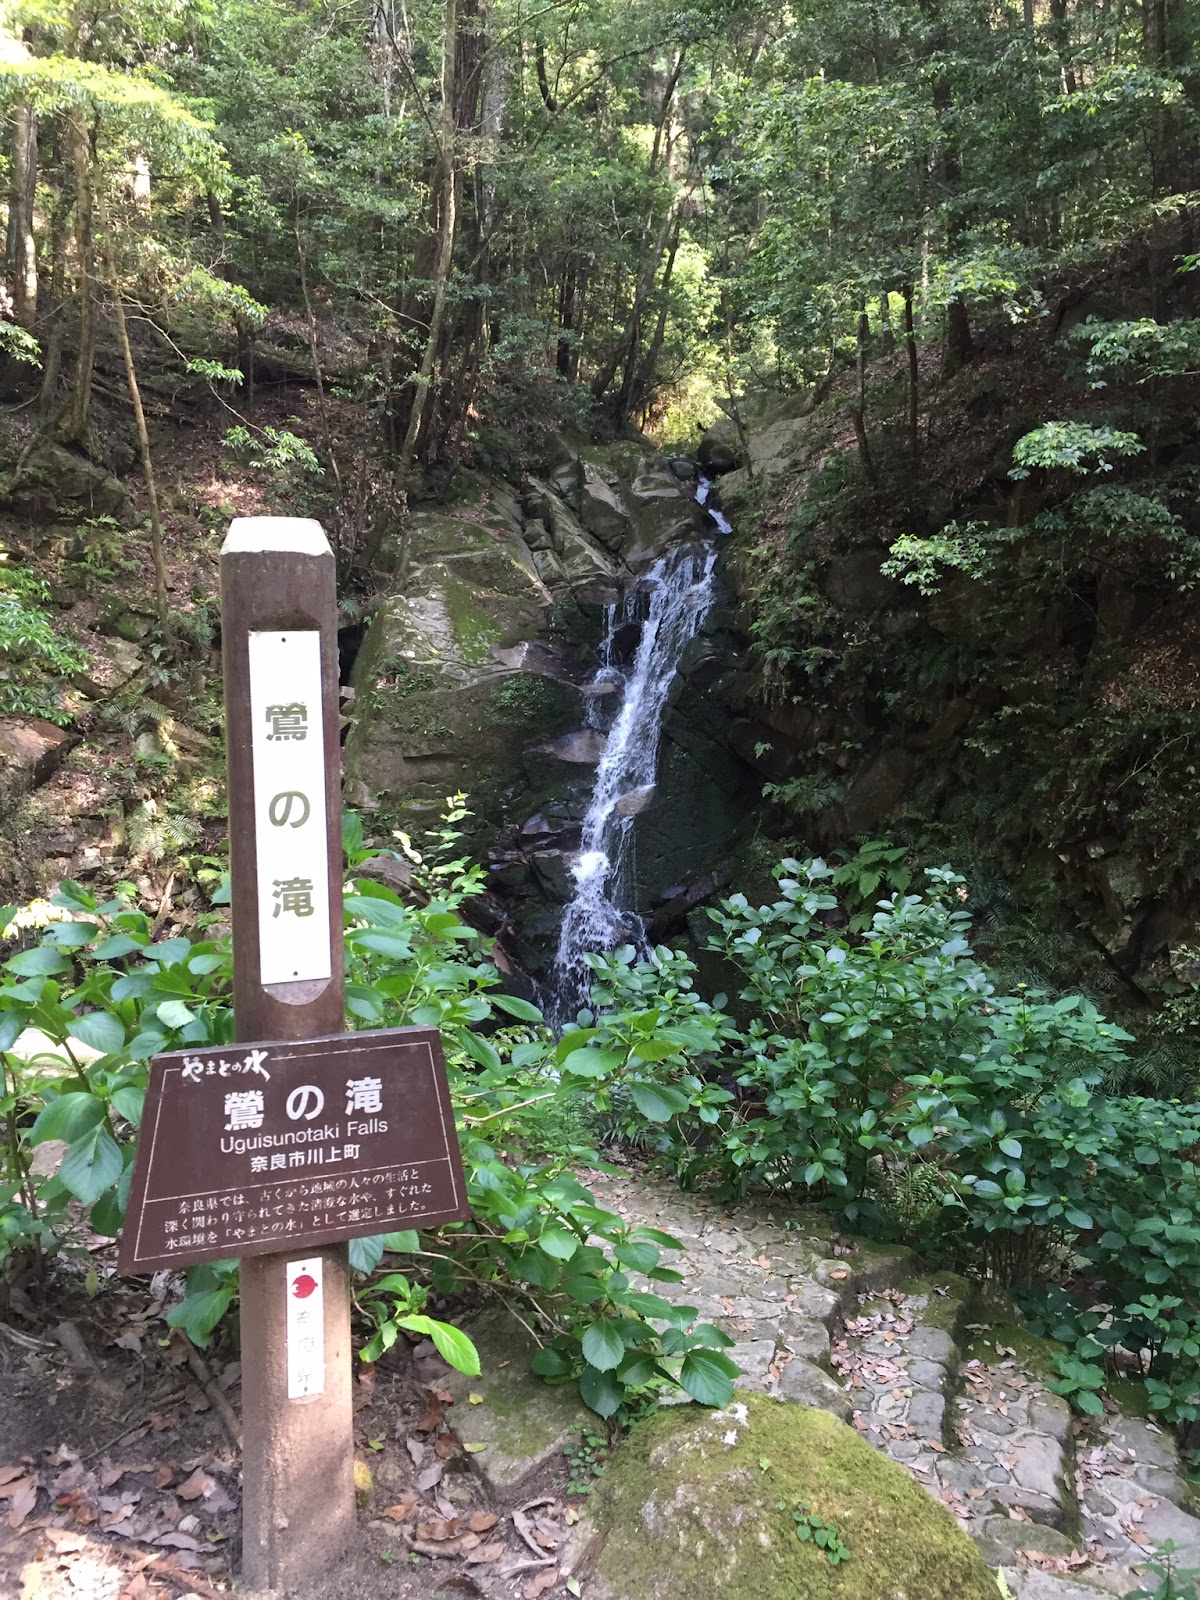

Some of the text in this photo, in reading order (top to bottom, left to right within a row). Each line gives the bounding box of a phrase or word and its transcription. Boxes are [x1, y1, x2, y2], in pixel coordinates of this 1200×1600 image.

[182, 1049, 270, 1083] やまとの水
[220, 1118, 389, 1153] Uguisunotaki Falls
[250, 1143, 360, 1173] 奈良市川上町
